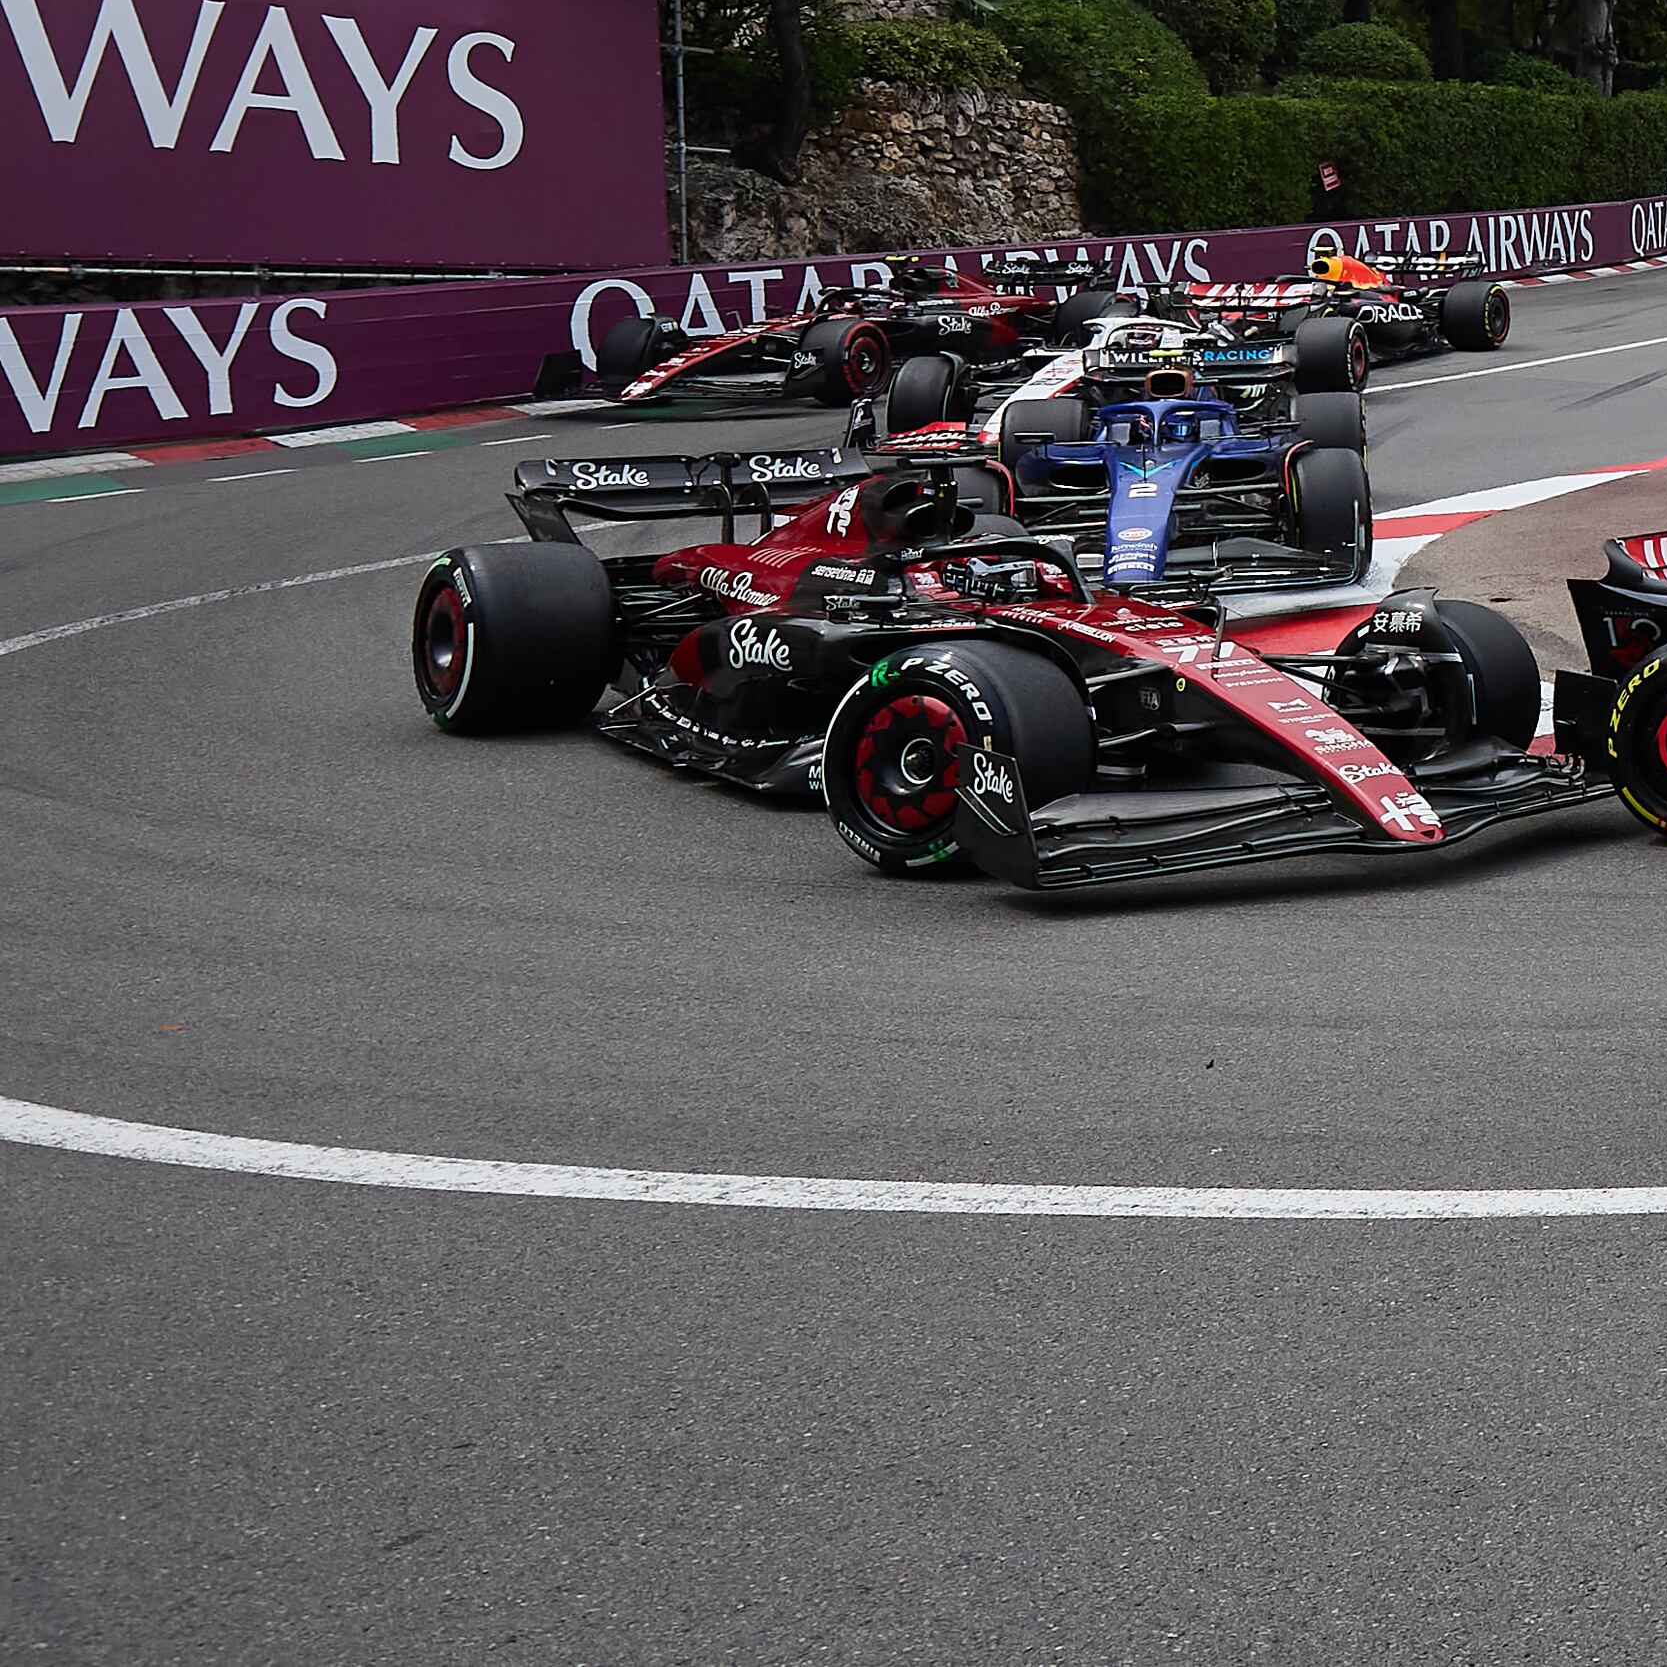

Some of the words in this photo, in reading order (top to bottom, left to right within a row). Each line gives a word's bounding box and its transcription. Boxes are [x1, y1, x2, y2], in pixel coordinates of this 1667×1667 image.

[1466, 209, 1595, 274] AIRWAYS
[1204, 349, 1270, 362] RACING
[571, 461, 650, 490] Stake
[749, 454, 823, 483] Stake
[1127, 483, 1158, 499] 2
[730, 571, 780, 607] Romeo
[729, 617, 792, 672] Stake
[1161, 641, 1237, 664] 77
[901, 656, 919, 671] P
[925, 660, 995, 723] ZERO
[1609, 658, 1661, 736] ZERO
[974, 753, 1014, 804] Stake
[1339, 762, 1404, 785] Stake
